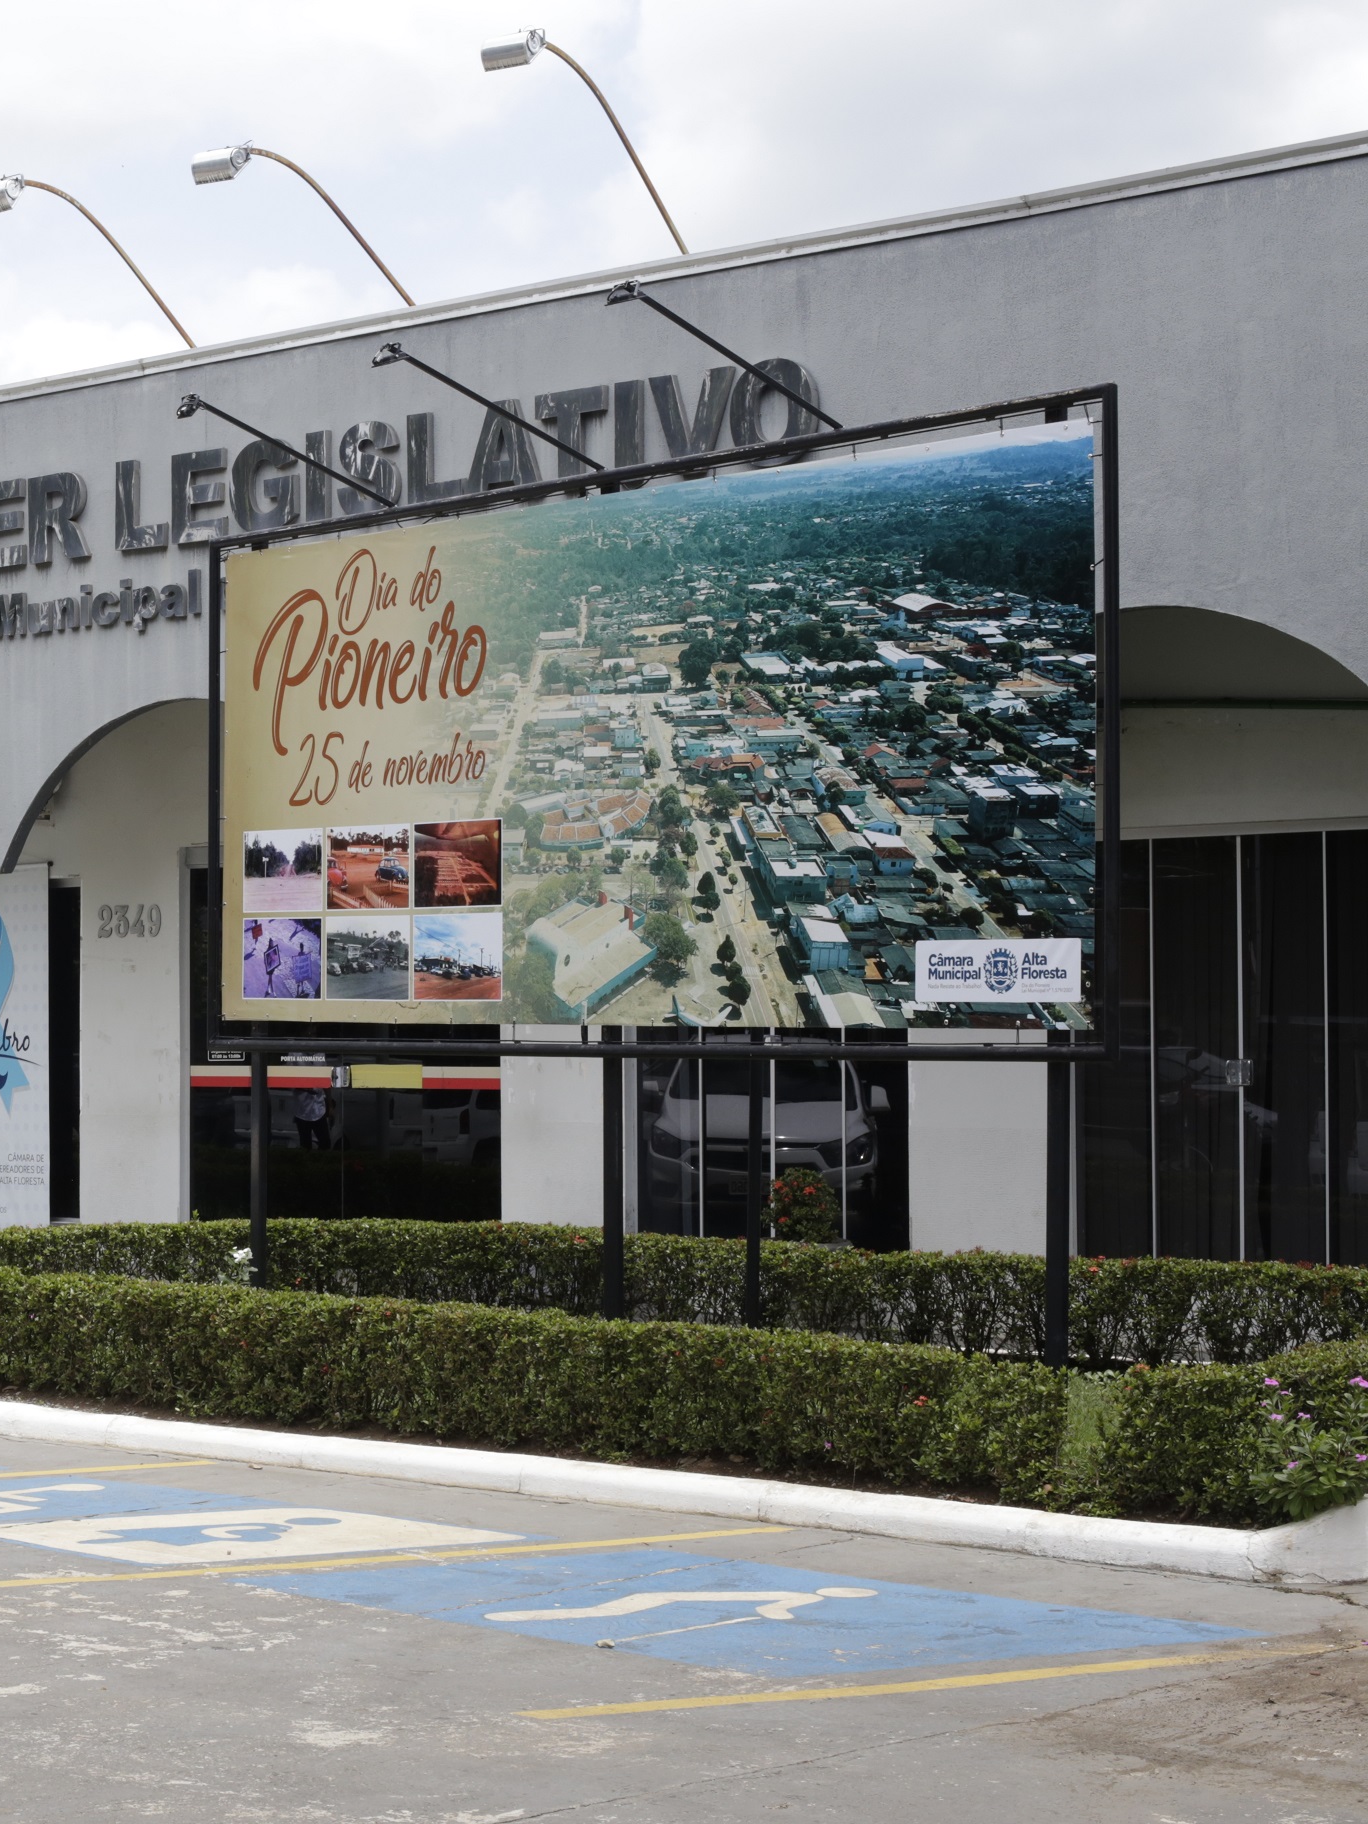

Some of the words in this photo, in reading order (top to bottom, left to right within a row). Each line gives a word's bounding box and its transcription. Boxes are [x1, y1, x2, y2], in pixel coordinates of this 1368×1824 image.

[115, 357, 820, 551] LEGISLATIVO
[335, 548, 398, 635] Dia
[410, 545, 441, 611] do
[252, 588, 487, 756] Pioneiro
[288, 731, 344, 806] 25
[347, 740, 373, 793] de
[383, 732, 486, 788] novembro
[97, 904, 162, 939] 2349
[928, 953, 973, 967] Câmara
[1021, 952, 1047, 966] Alta
[928, 967, 981, 982] Municipal
[1021, 967, 1067, 979] Floresta
[7, 1152, 34, 1162] CÂMARA
[36, 1154, 45, 1163] DE
[36, 1165, 45, 1174] DE
[0, 1176, 13, 1185] ALTA
[13, 1177, 45, 1186] FLORESTA
